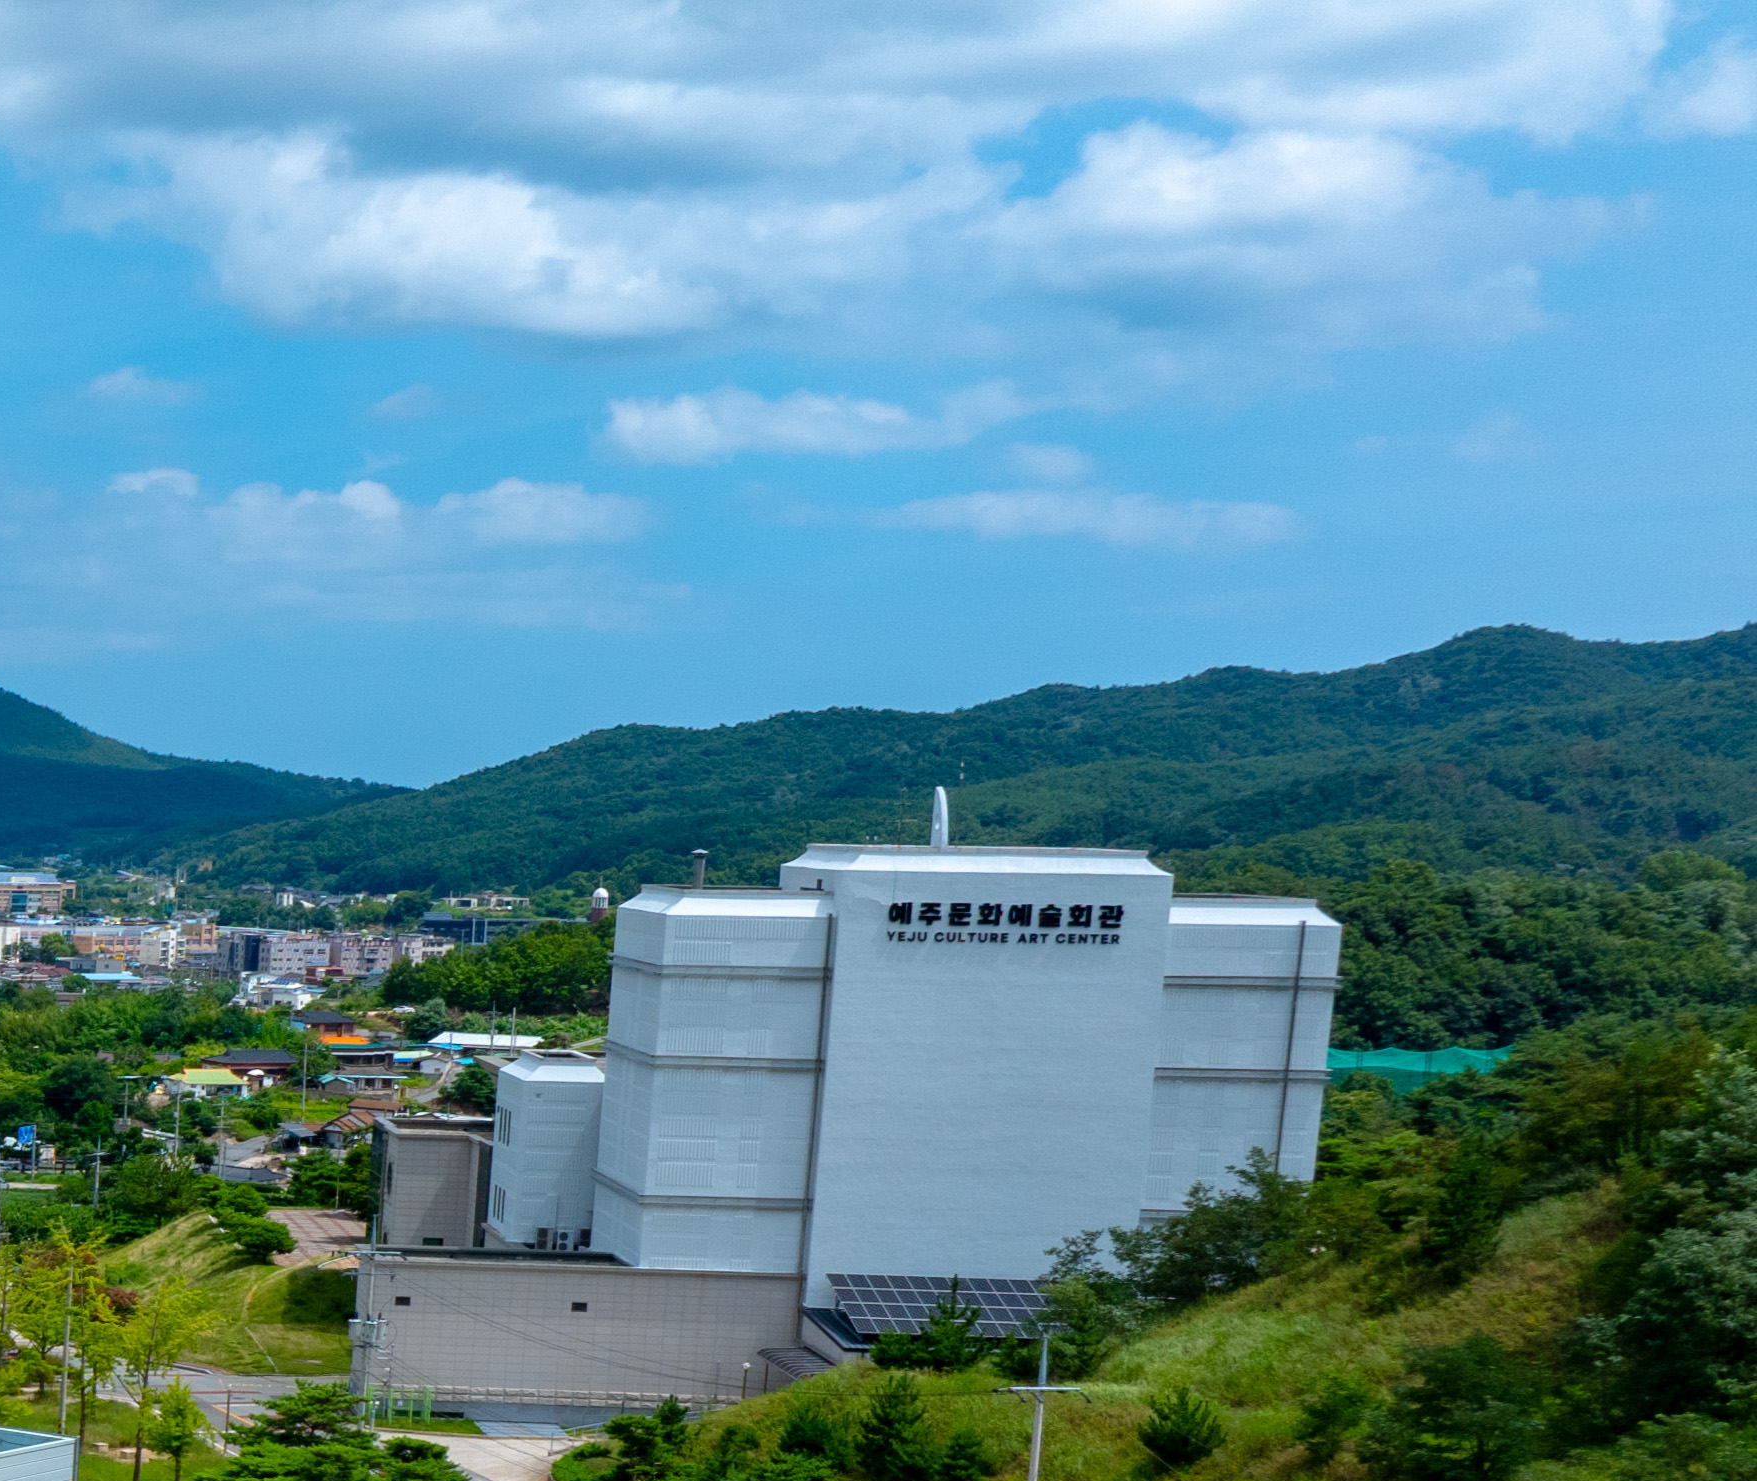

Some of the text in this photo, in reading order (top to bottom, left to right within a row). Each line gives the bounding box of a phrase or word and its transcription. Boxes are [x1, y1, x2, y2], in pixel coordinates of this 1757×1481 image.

[888, 902, 1125, 929] 예주문화예술회관
[887, 930, 1121, 945] YEJU CULTURE ART CENTER
